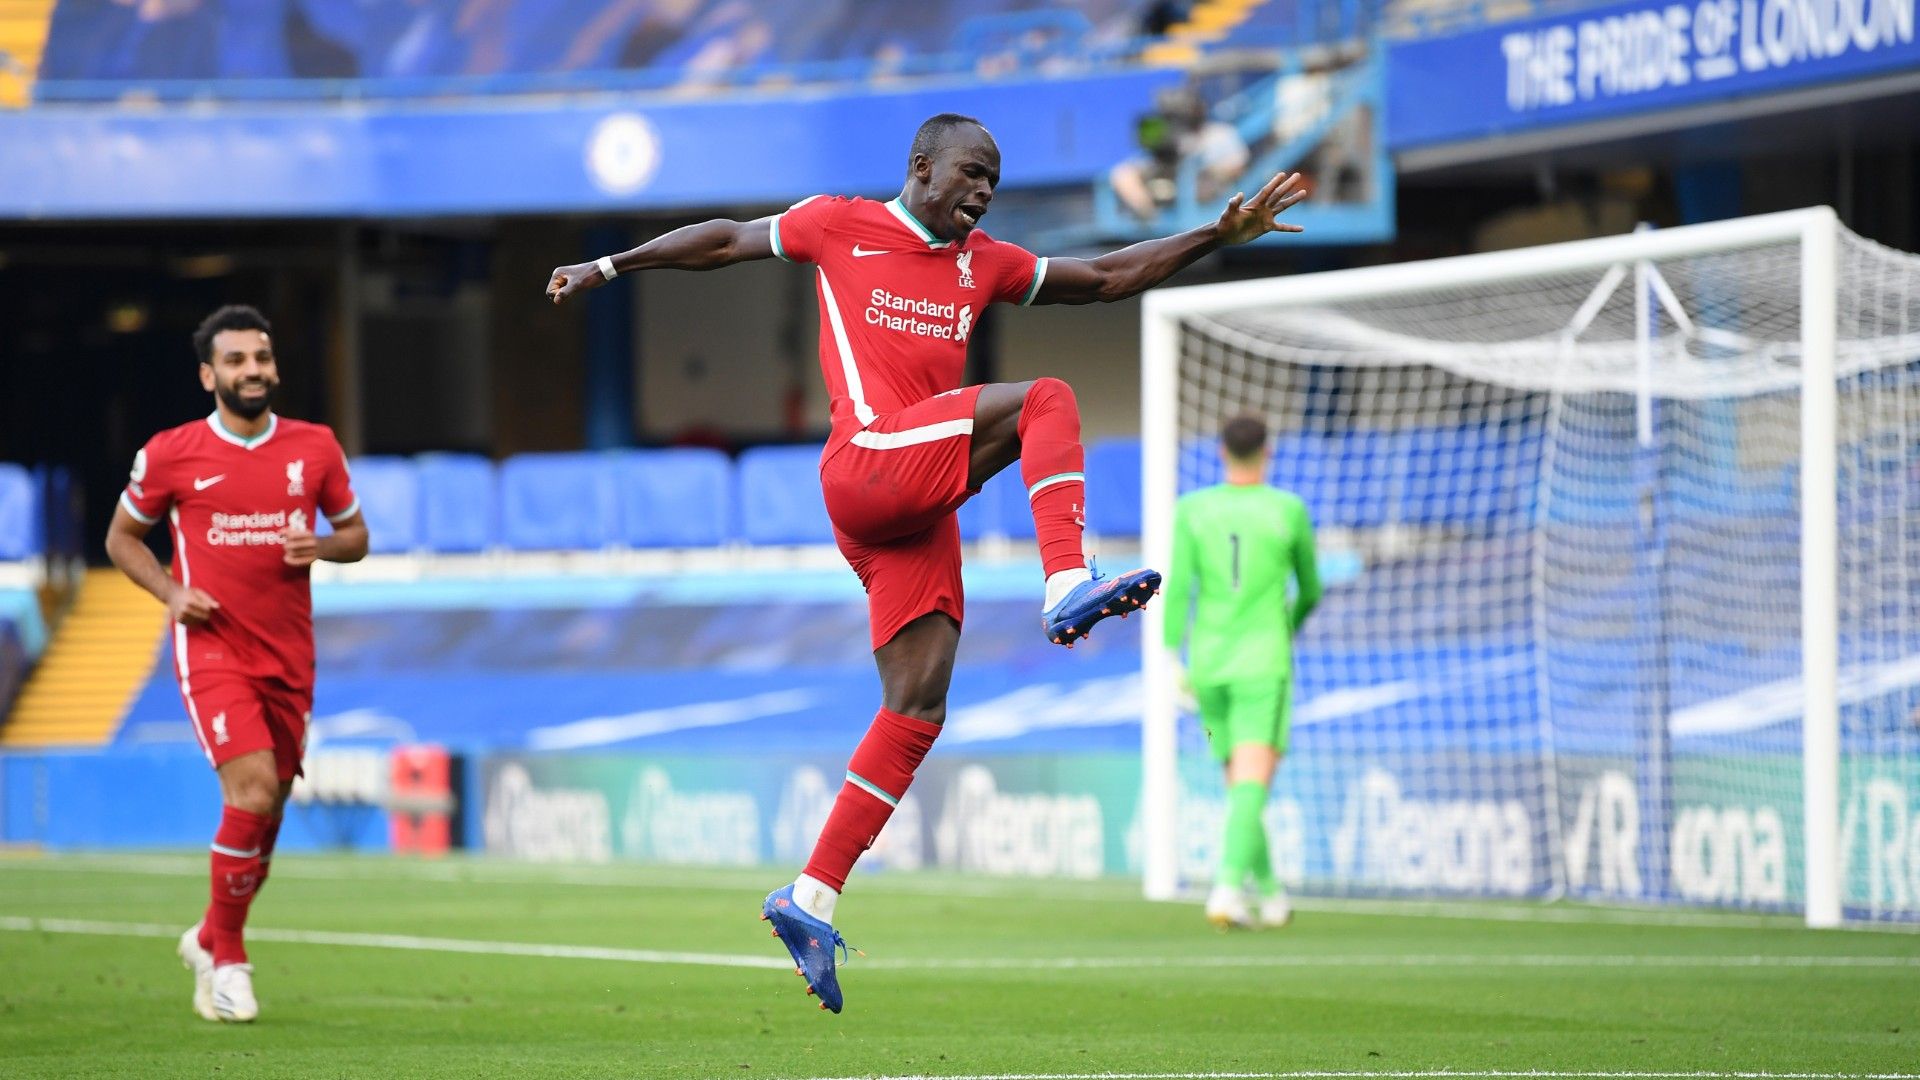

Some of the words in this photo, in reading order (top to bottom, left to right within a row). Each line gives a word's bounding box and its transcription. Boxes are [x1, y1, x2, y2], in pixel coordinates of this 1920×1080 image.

[1502, 25, 1575, 111] THE
[1577, 4, 1691, 100] PRIDE
[1693, 0, 1739, 58] OF
[1740, 0, 1914, 71] LONDON
[865, 307, 953, 339] Chartered
[871, 288, 954, 320] Standard
[211, 510, 286, 529] Standard
[1229, 532, 1240, 589] 1
[1340, 769, 1532, 892] Rexona
